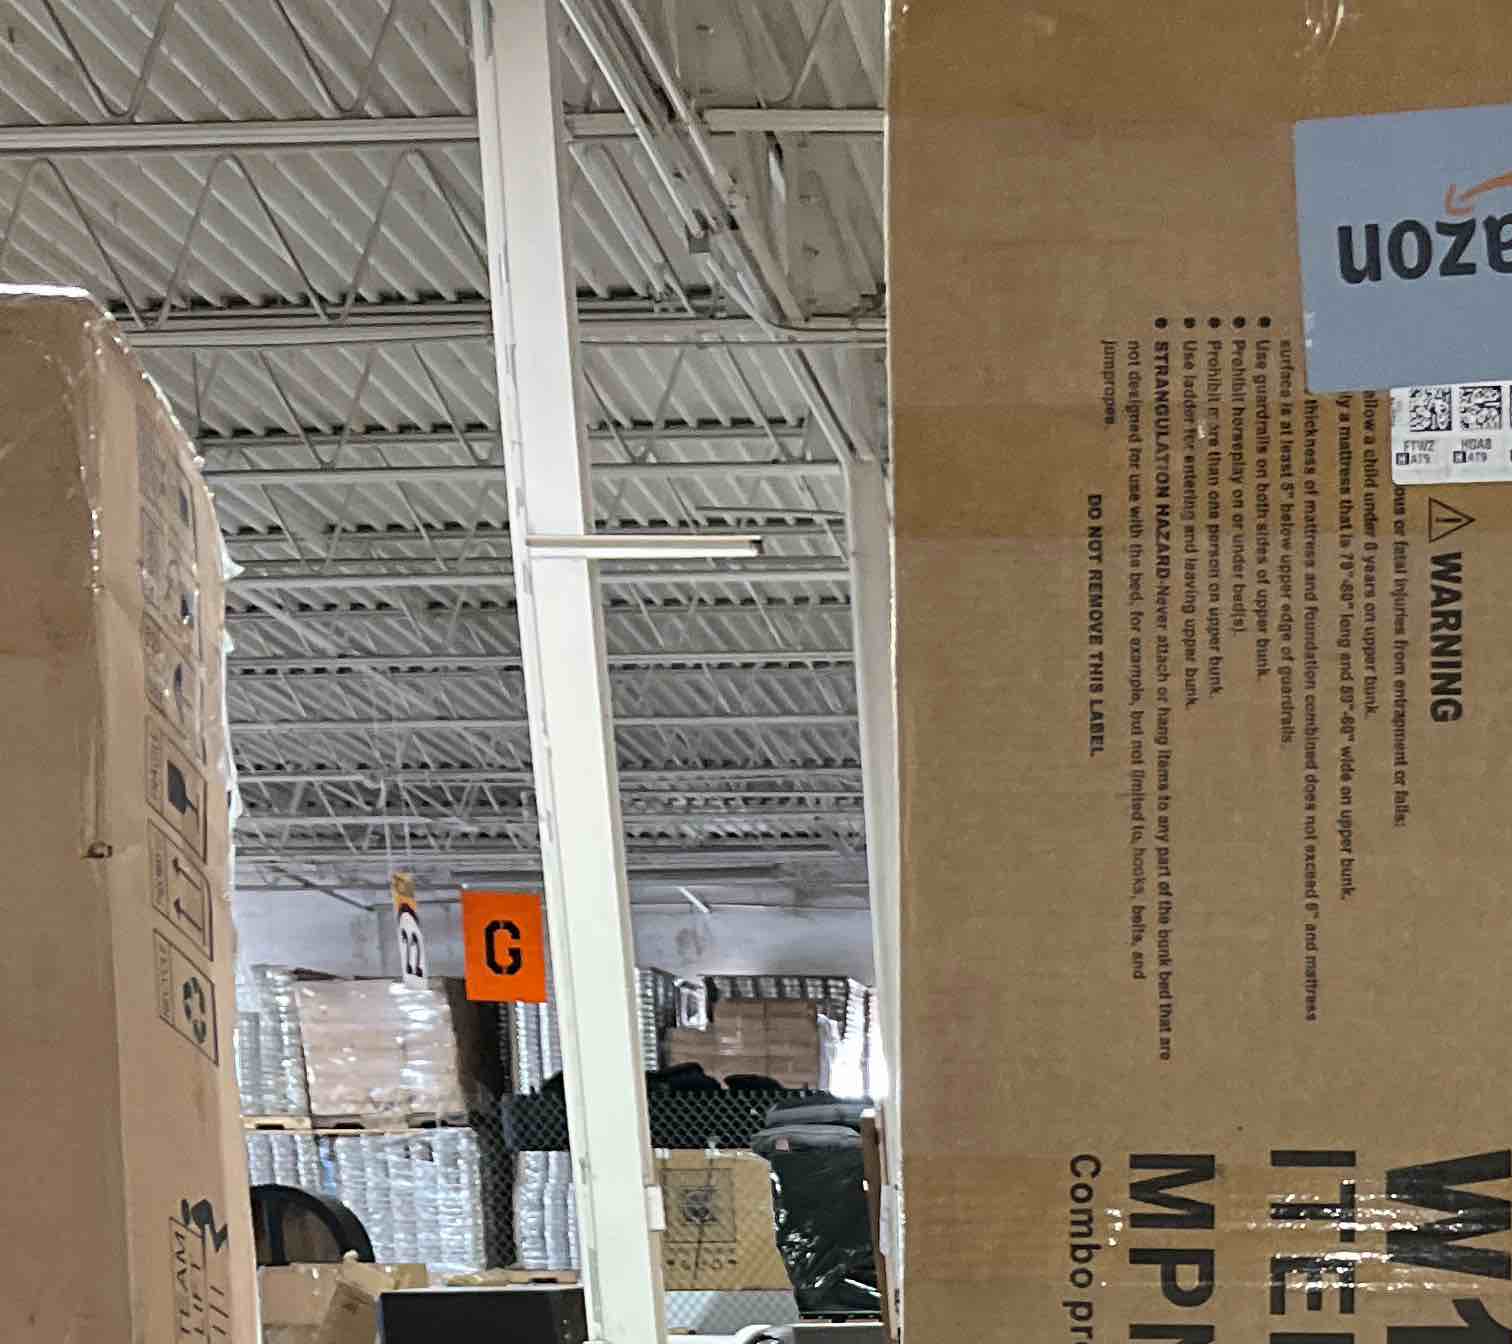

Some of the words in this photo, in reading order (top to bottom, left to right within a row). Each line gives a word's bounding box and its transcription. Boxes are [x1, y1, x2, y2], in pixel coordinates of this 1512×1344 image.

[1087, 493, 1103, 520] DO
[1087, 524, 1104, 565] NOT
[1087, 568, 1104, 645] REMOVE
[1428, 552, 1462, 723] WARNING
[1087, 650, 1104, 693] THIS
[1088, 698, 1105, 758] LABEL
[484, 920, 522, 976] G
[1068, 1153, 1106, 1288] Combo
